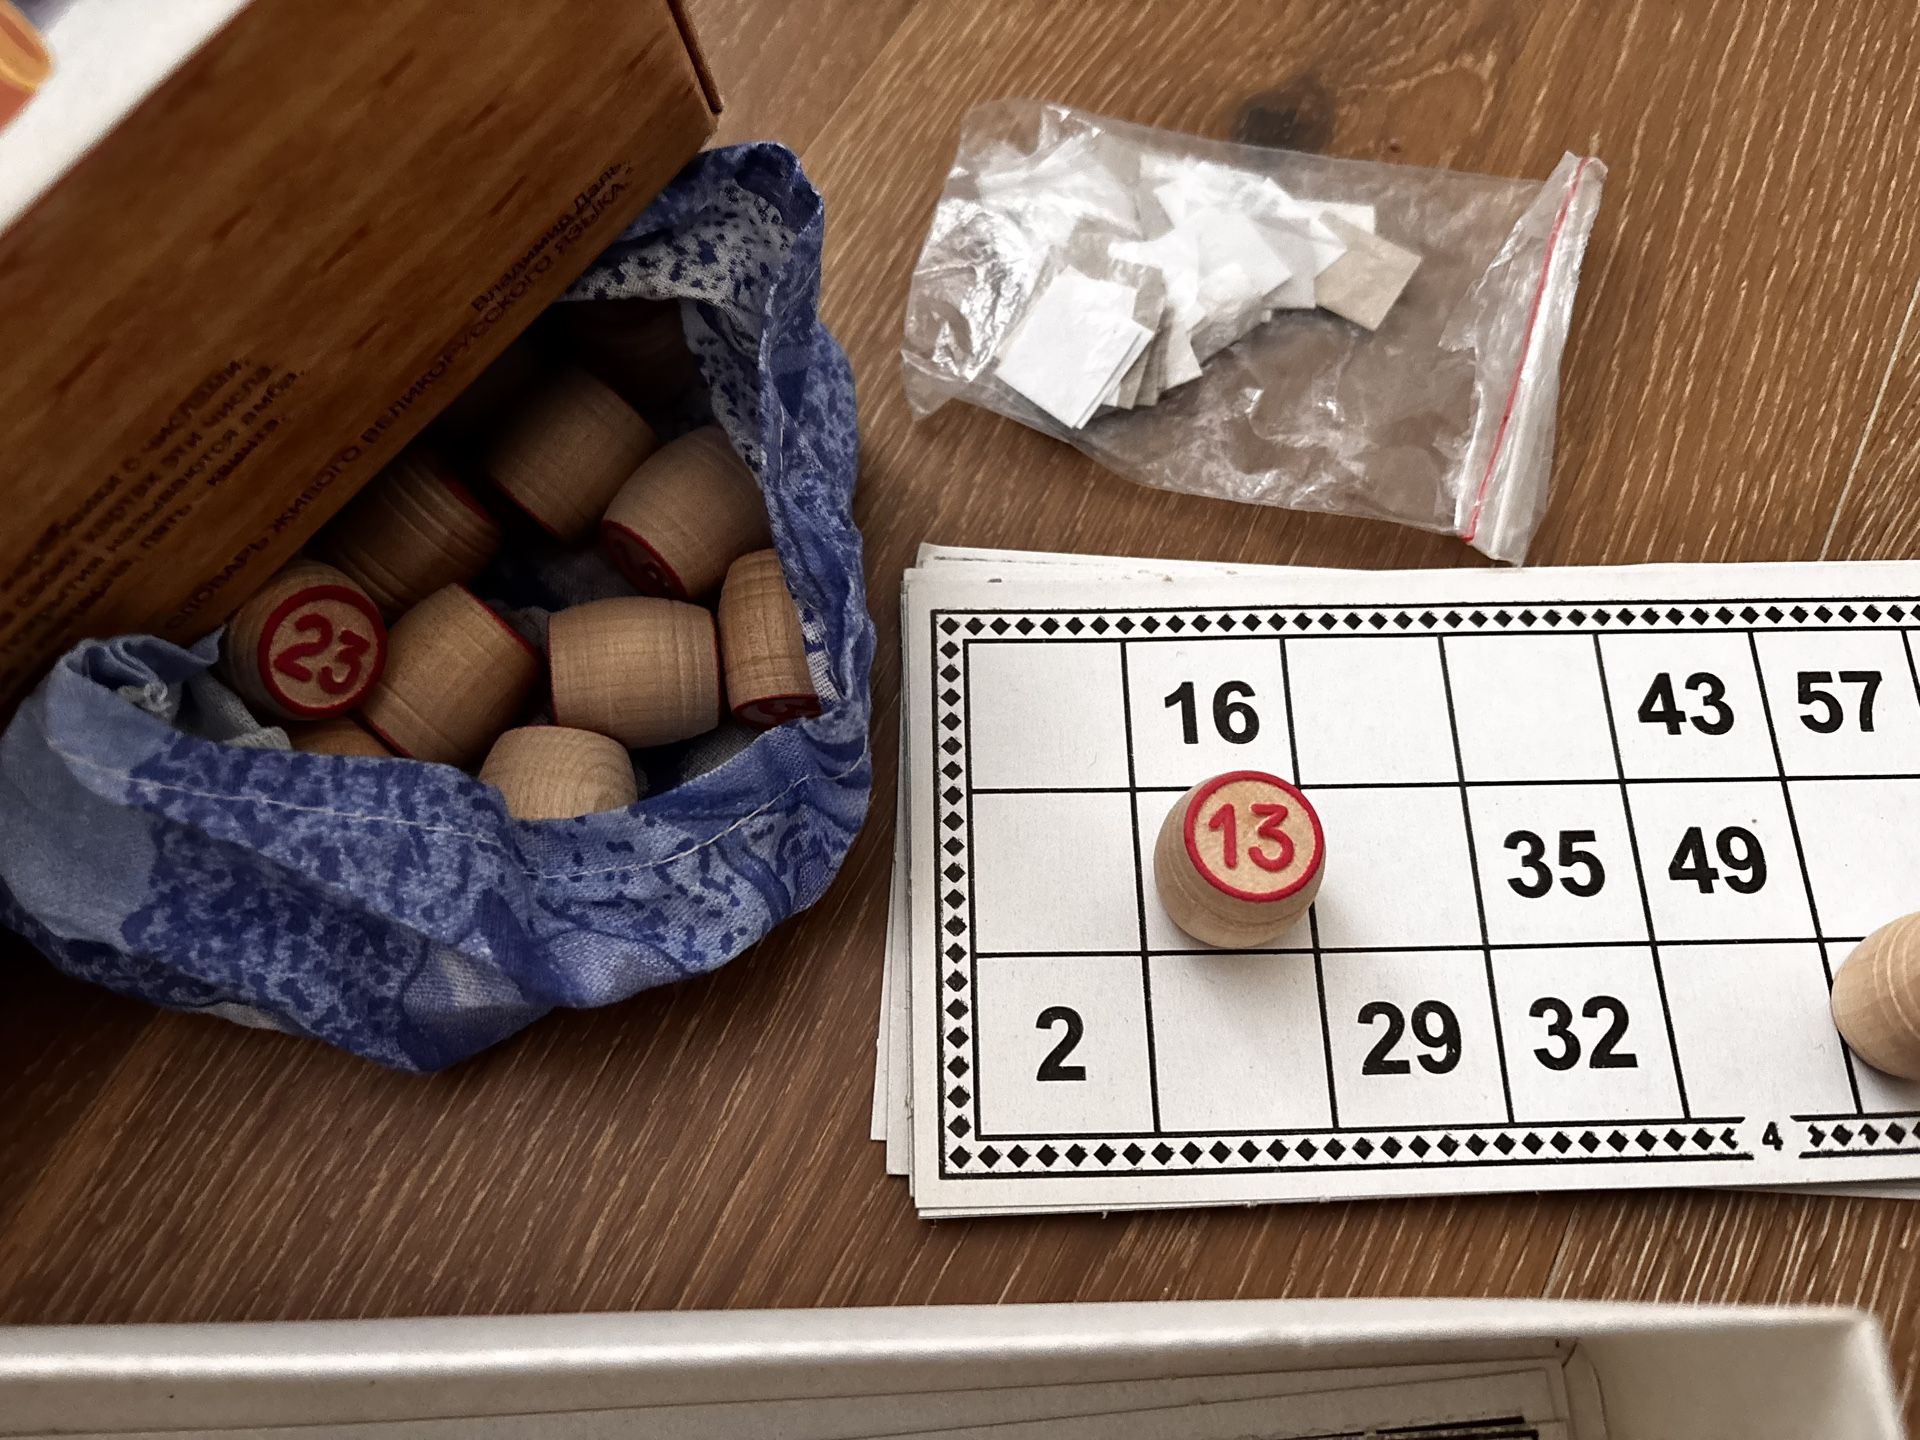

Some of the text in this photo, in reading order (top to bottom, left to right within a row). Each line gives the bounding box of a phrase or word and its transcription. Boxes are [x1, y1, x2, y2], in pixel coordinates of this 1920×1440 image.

[472, 214, 575, 309] Владимир
[273, 446, 361, 534] ЖИВОГО
[360, 254, 554, 444] ВЕЛИКОРУССКОГО
[273, 613, 371, 695] 23
[1164, 670, 1883, 744] 16 43 57
[1208, 802, 1295, 872] 13
[1503, 826, 1768, 898] 35 49
[1035, 995, 1639, 1081] 2 29 32
[1761, 1121, 1784, 1151] 4
